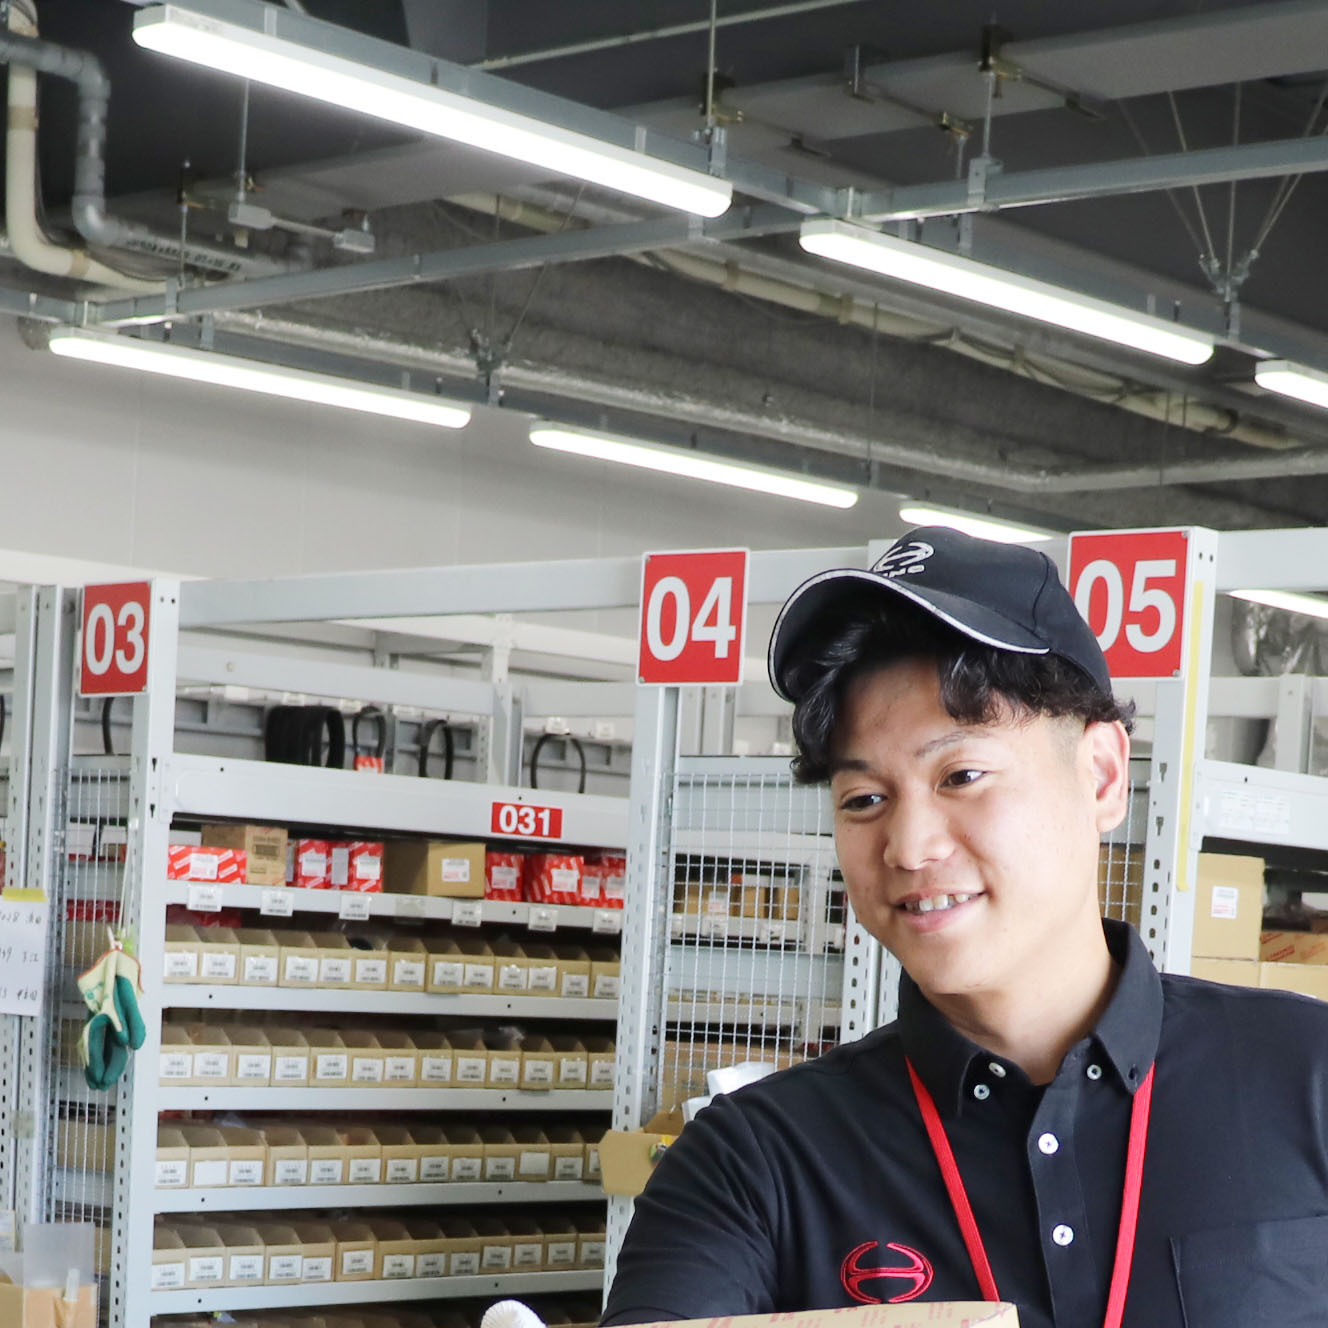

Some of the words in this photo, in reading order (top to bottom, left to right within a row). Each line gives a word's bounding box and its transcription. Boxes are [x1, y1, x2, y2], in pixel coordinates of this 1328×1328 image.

[85, 601, 146, 676] 03
[646, 575, 737, 662] 04
[1073, 559, 1177, 654] 05
[498, 804, 551, 837] 031
